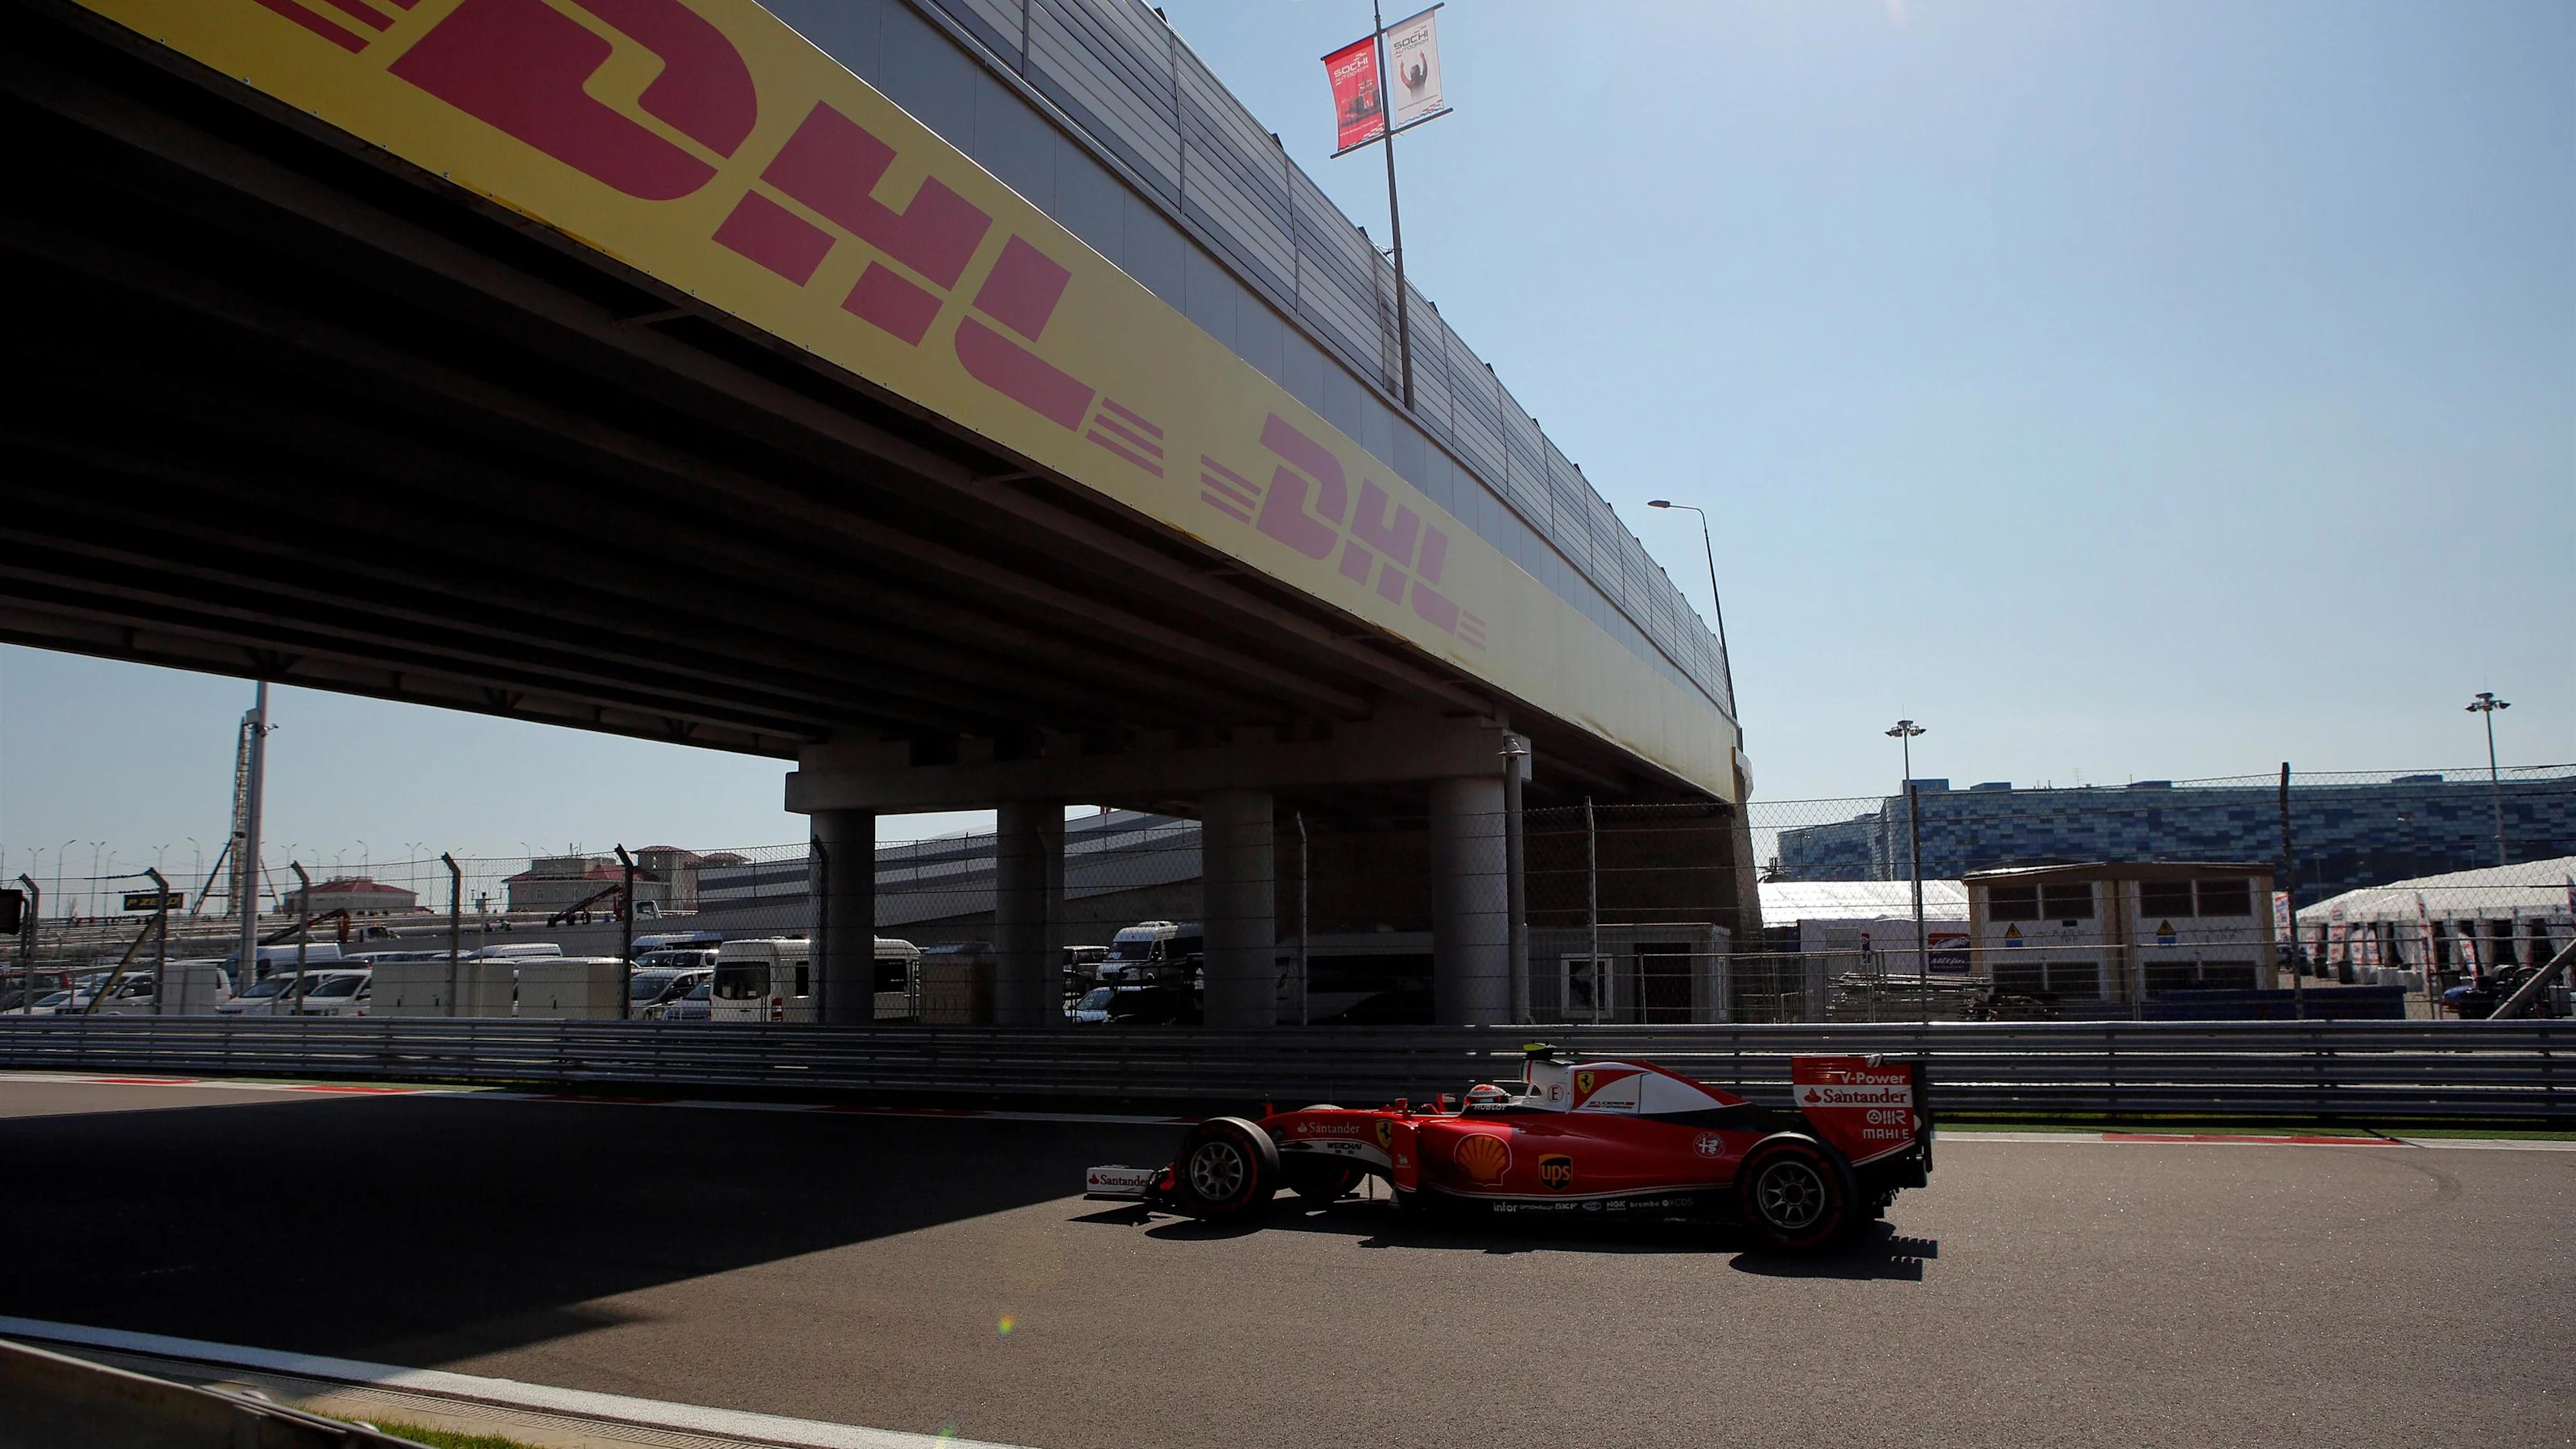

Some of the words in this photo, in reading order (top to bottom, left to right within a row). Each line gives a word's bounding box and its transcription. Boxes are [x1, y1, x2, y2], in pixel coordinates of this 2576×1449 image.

[1393, 29, 1429, 51] SOCHI
[1394, 38, 1430, 56] AUTODROM
[1333, 56, 1368, 78] SOCHI
[1334, 64, 1369, 84] AUTODROM
[386, 0, 1096, 432] DHL
[1255, 411, 1459, 634] DHL
[139, 896, 179, 906] ZEO
[1841, 1071, 1906, 1084] V-Power
[1551, 1087, 1558, 1100] E
[1823, 1088, 1907, 1103] Santander
[1309, 1121, 1361, 1134] Santander
[1863, 1129, 1909, 1139] MAHLE
[1327, 1141, 1362, 1150] WEICHAI
[1541, 1165, 1571, 1186] ups
[1493, 1201, 1518, 1212] infor
[1554, 1203, 1579, 1211] SKF
[1606, 1200, 1626, 1208] NGK
[1629, 1200, 1660, 1208] brembo
